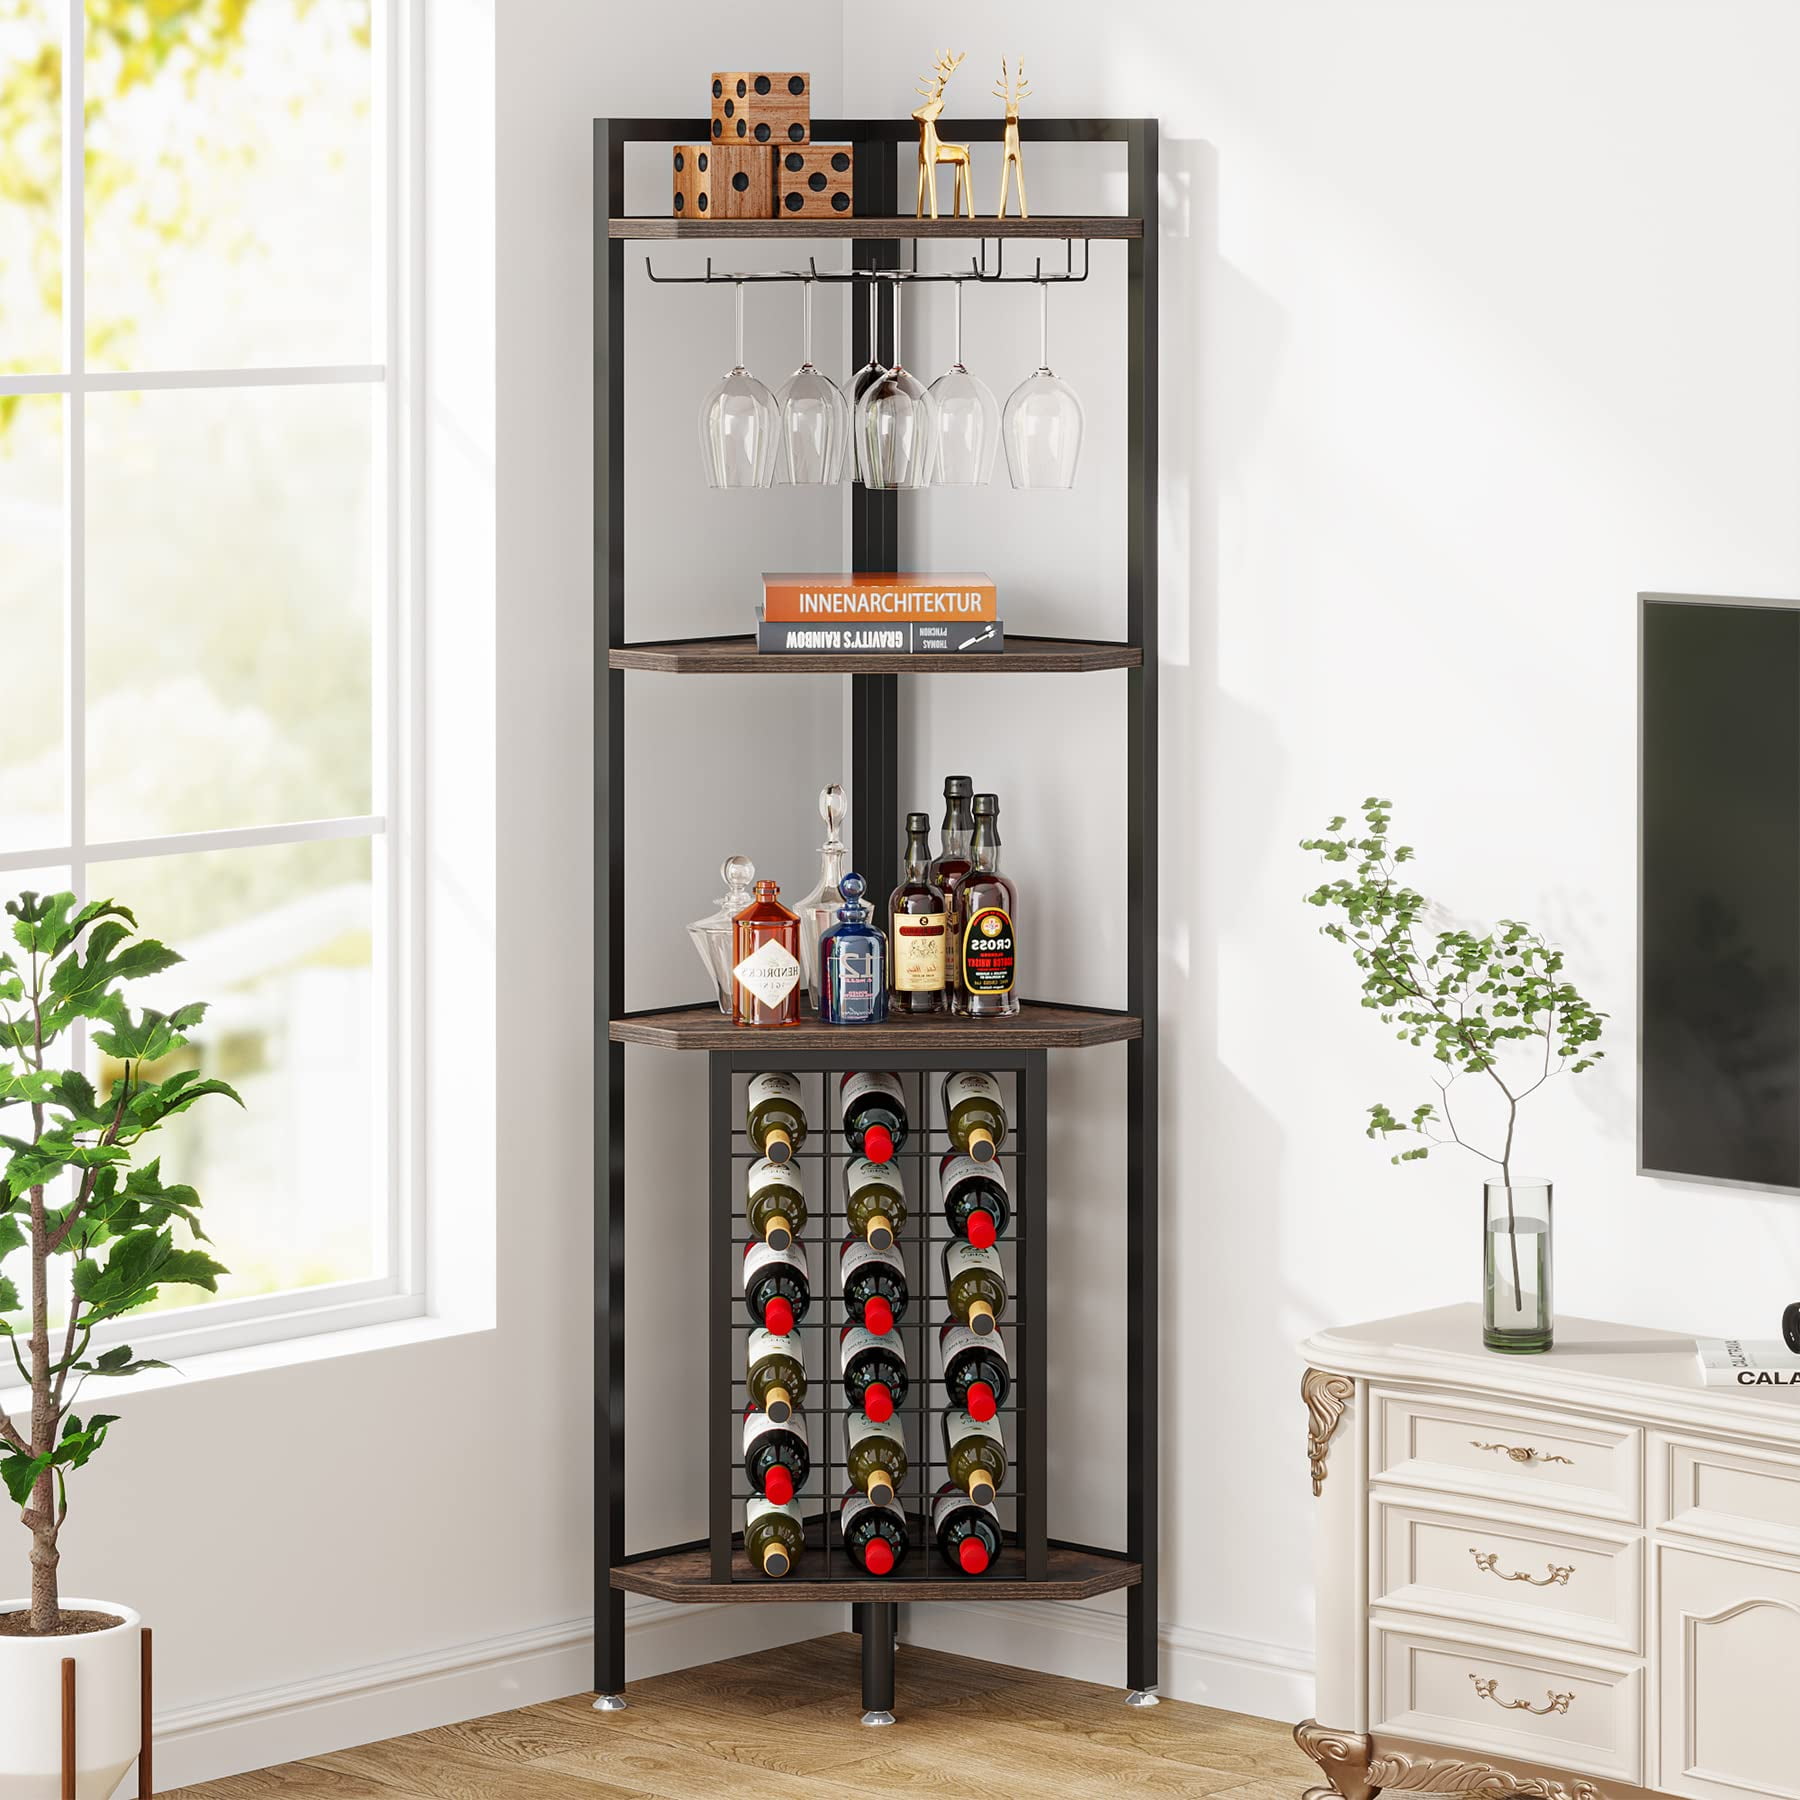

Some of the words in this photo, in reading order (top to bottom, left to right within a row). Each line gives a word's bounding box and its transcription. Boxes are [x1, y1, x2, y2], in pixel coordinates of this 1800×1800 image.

[799, 592, 982, 613] INNENARCHITEKTUR
[786, 630, 841, 649] RAINBOW
[843, 630, 904, 649] GRAVITY'S
[922, 639, 948, 649] THOMAS
